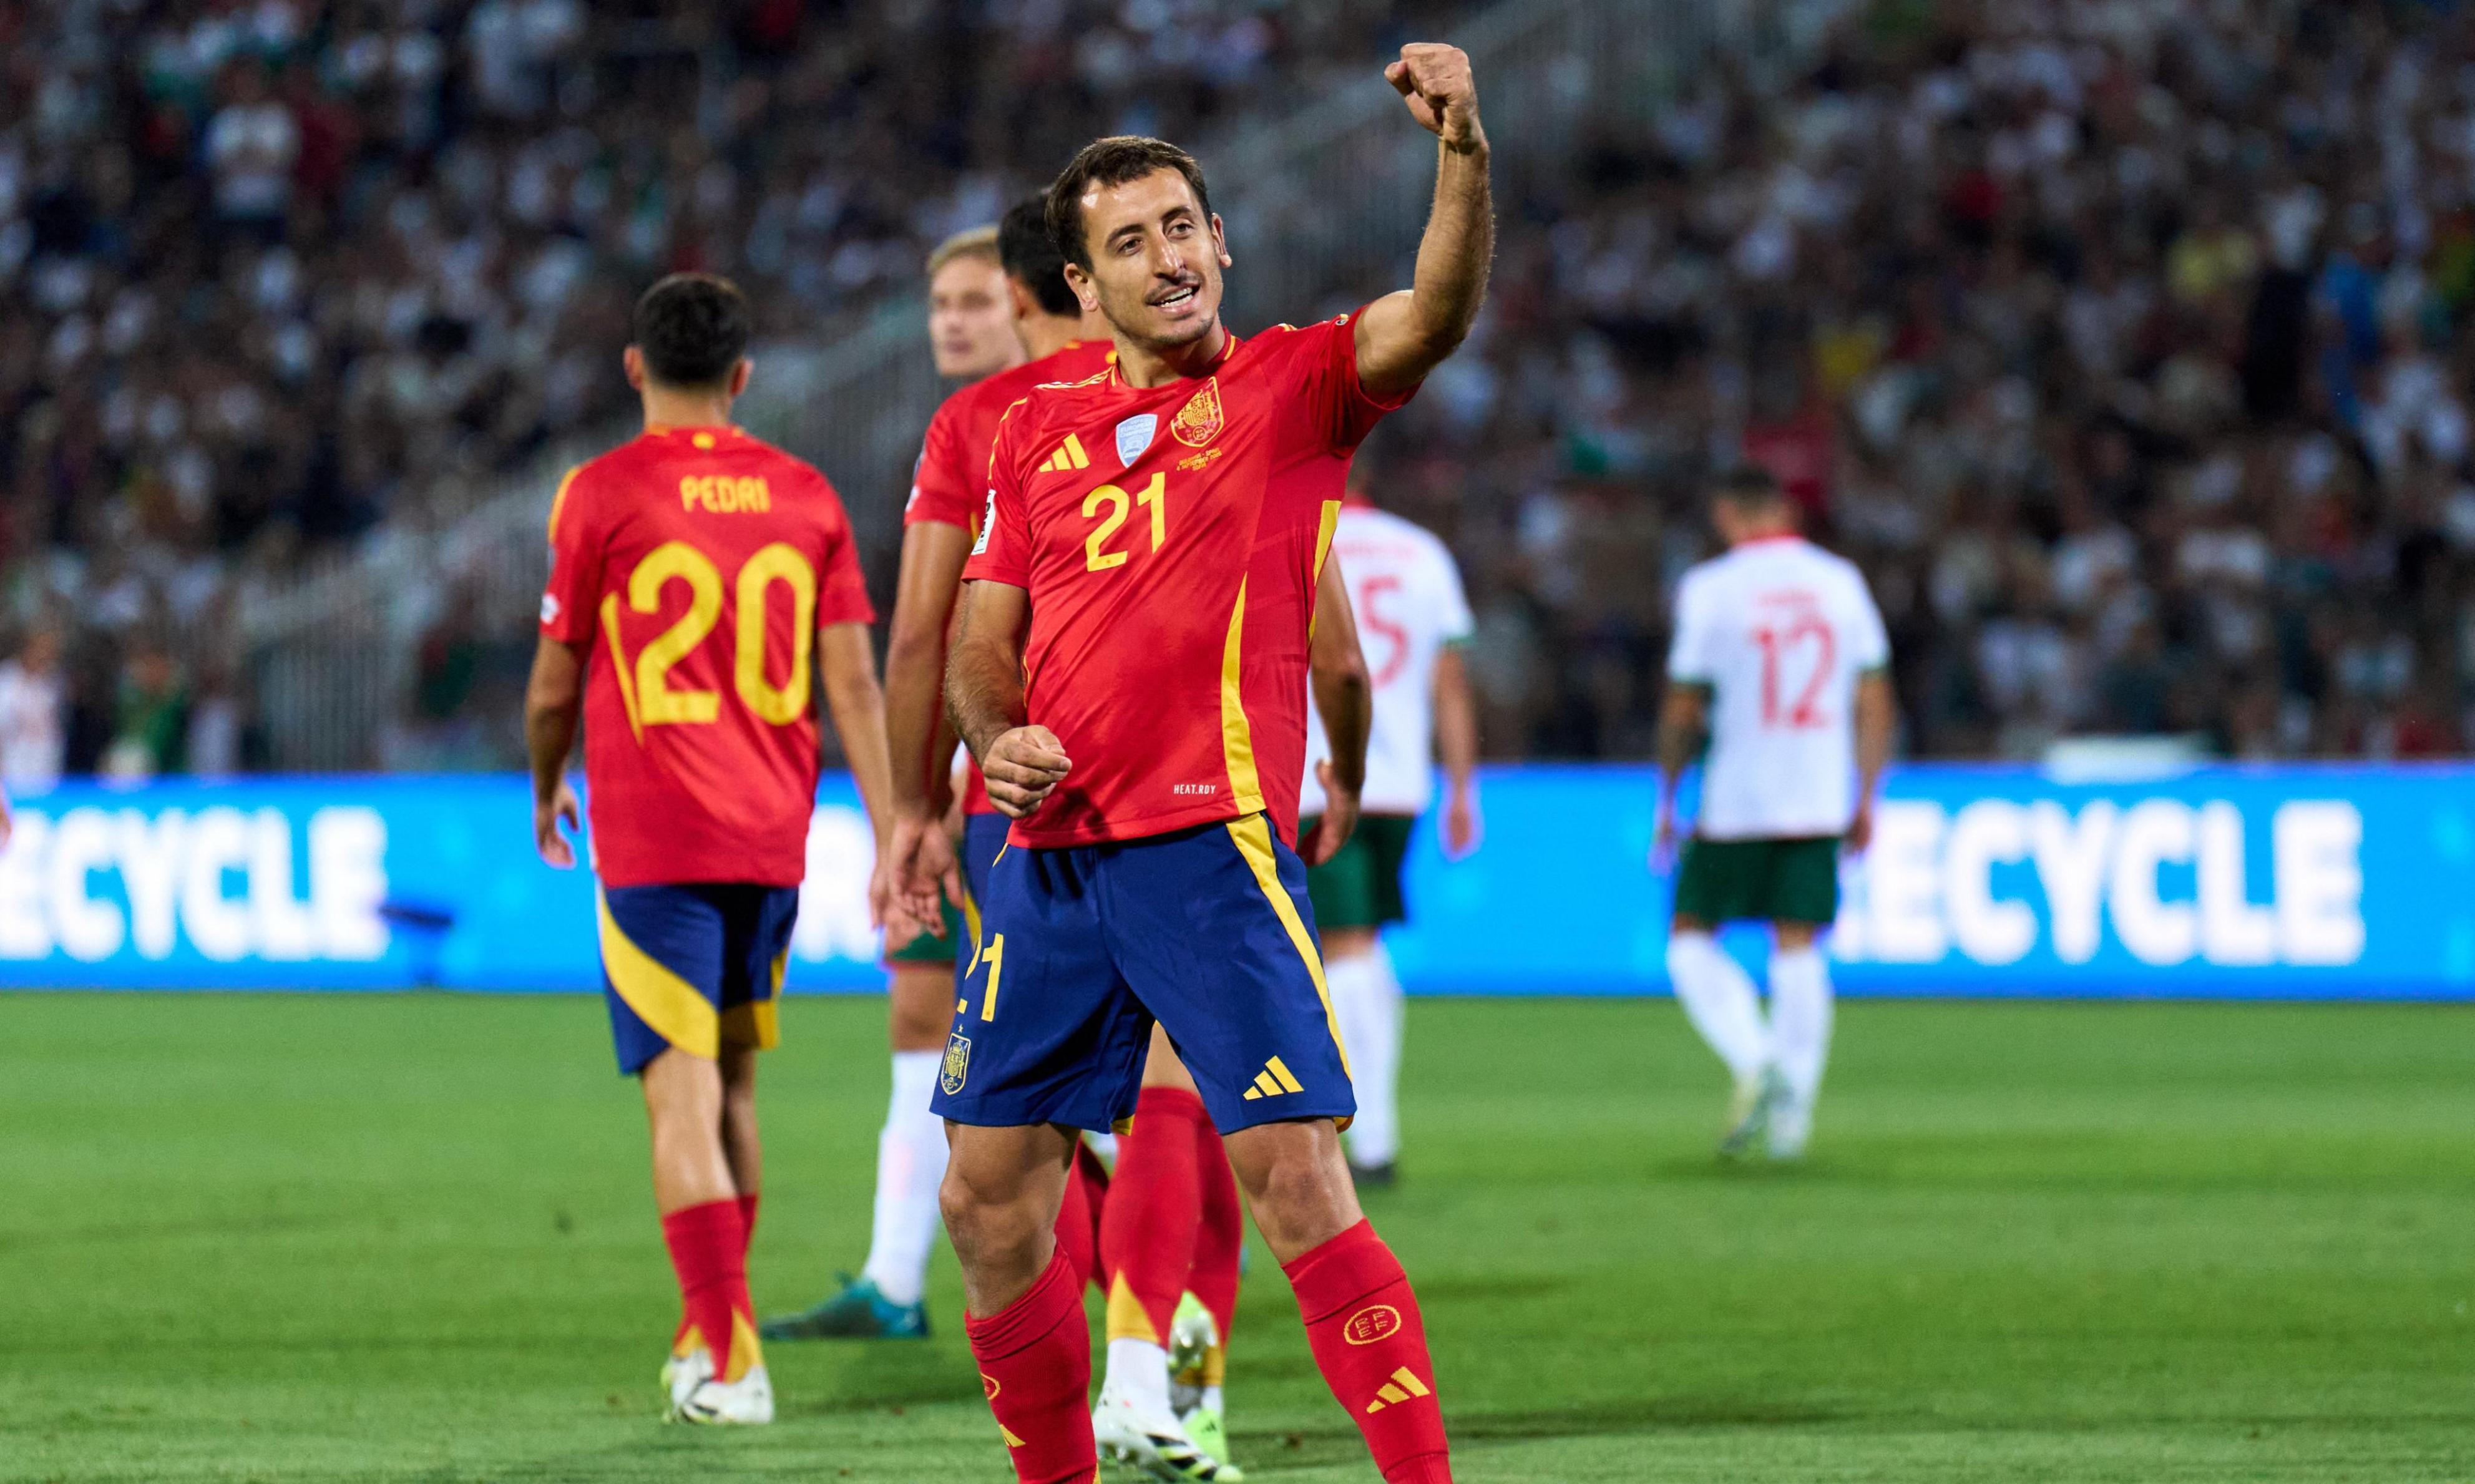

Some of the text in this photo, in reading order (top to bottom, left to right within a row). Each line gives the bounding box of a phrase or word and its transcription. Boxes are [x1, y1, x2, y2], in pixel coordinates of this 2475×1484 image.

[680, 475, 771, 513] PEDRI
[1082, 471, 1165, 572] 21
[629, 541, 816, 726] 20
[1747, 617, 1835, 729] 12
[1174, 784, 1216, 794] HEAT.RDY
[1833, 799, 2367, 966] ECYCLE
